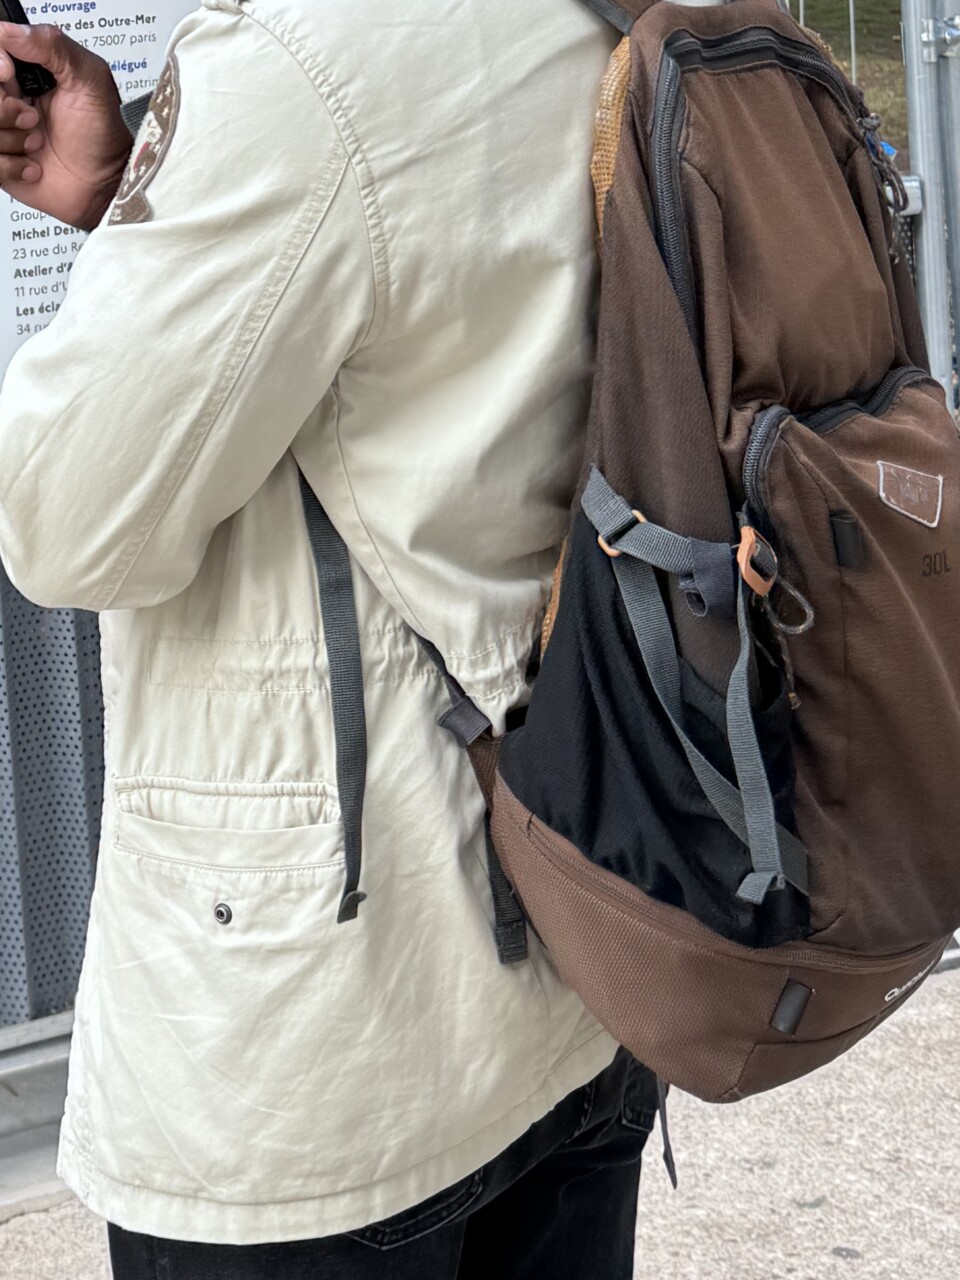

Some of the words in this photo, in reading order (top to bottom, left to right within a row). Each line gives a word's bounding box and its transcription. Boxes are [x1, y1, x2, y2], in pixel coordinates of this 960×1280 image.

[40, 1, 97, 14] d'ouvrage
[74, 20, 95, 30] des
[98, 14, 157, 29] Outre-Mer
[92, 34, 126, 48] 75007
[130, 30, 157, 46] paris
[108, 58, 148, 73] élégué
[11, 210, 47, 222] Group
[12, 226, 50, 242] Michel
[12, 249, 27, 260] 23
[30, 246, 49, 258] rue
[52, 244, 68, 255] du
[14, 264, 54, 280] Atelier
[14, 286, 25, 297] 11
[29, 284, 48, 296] rue
[16, 306, 35, 317] Les
[16, 324, 30, 336] 34
